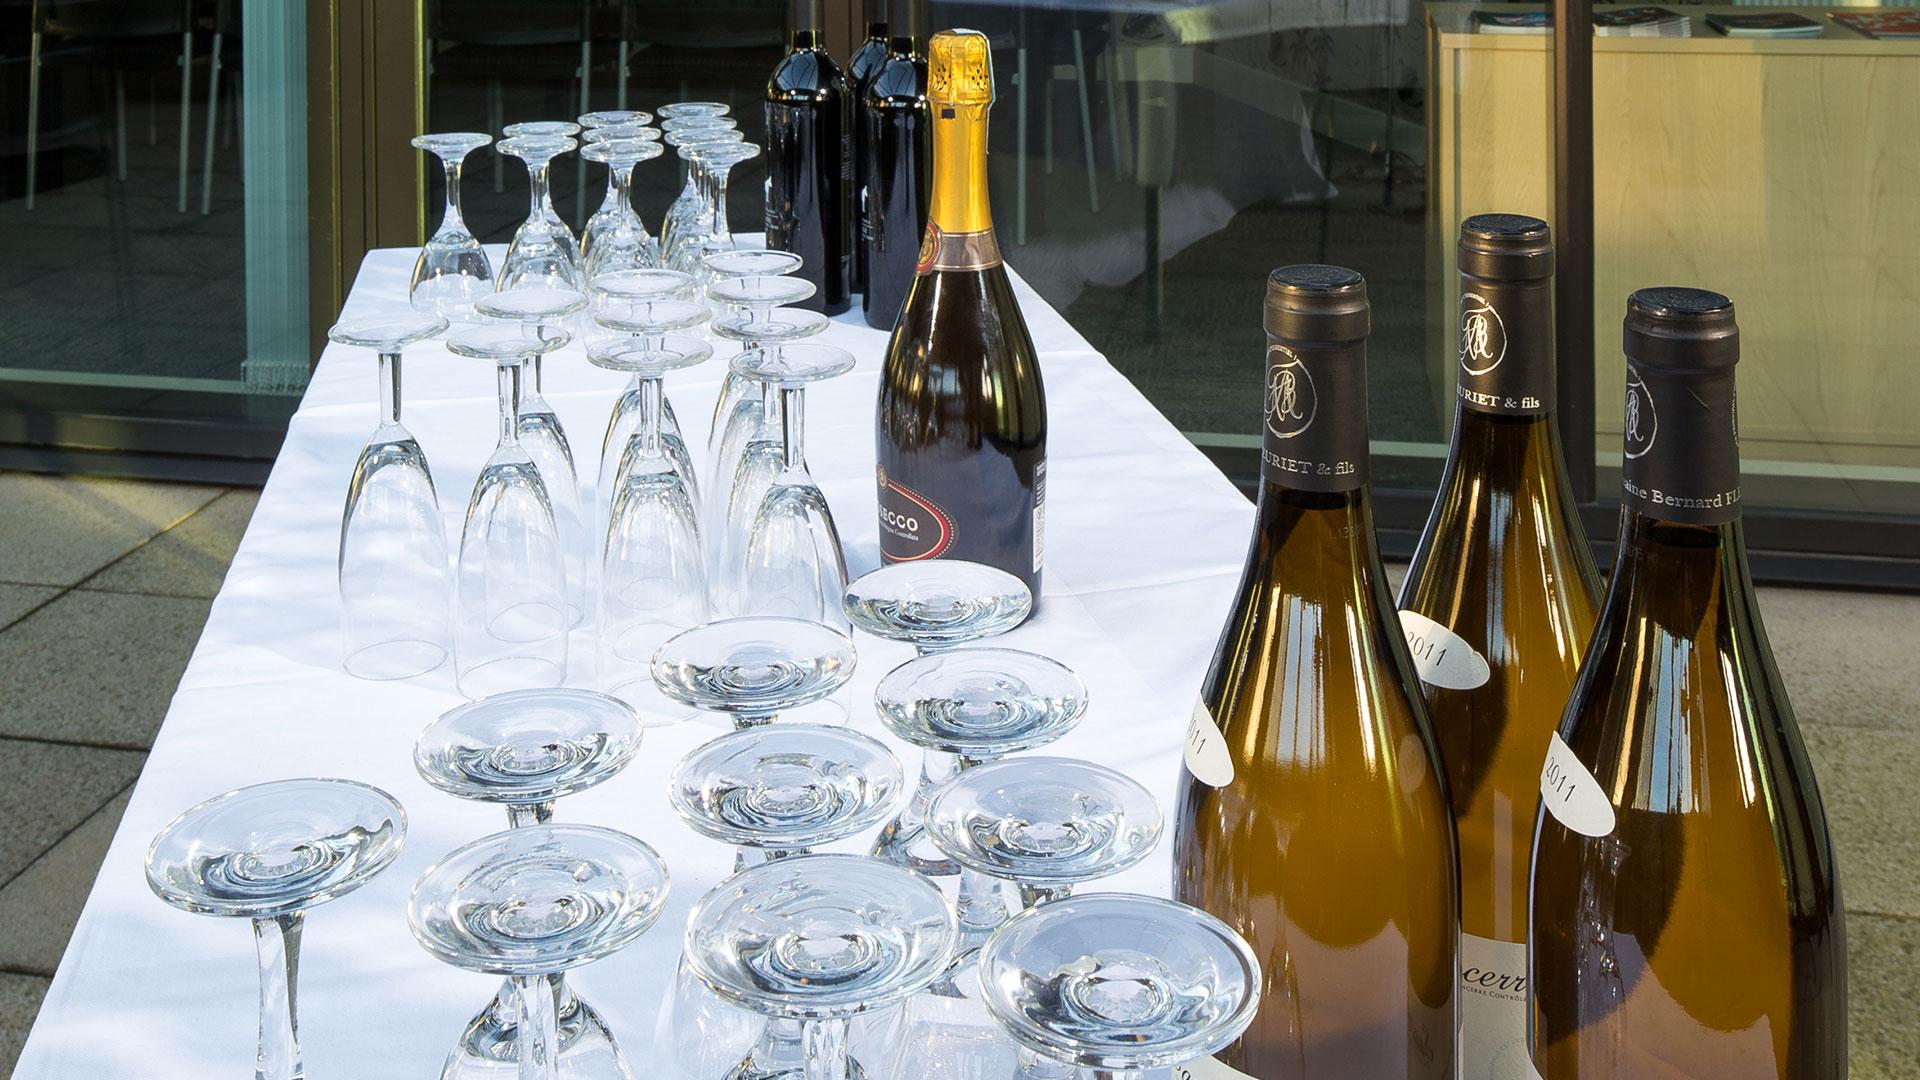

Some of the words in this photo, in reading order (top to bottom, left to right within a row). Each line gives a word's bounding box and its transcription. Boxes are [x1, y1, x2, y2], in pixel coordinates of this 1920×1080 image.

[1504, 397, 1517, 409] &
[1521, 396, 1540, 409] fils
[1317, 463, 1330, 475] &
[1335, 461, 1355, 475] fils
[1651, 489, 1722, 508] Bernard
[1546, 756, 1576, 802] 2011
